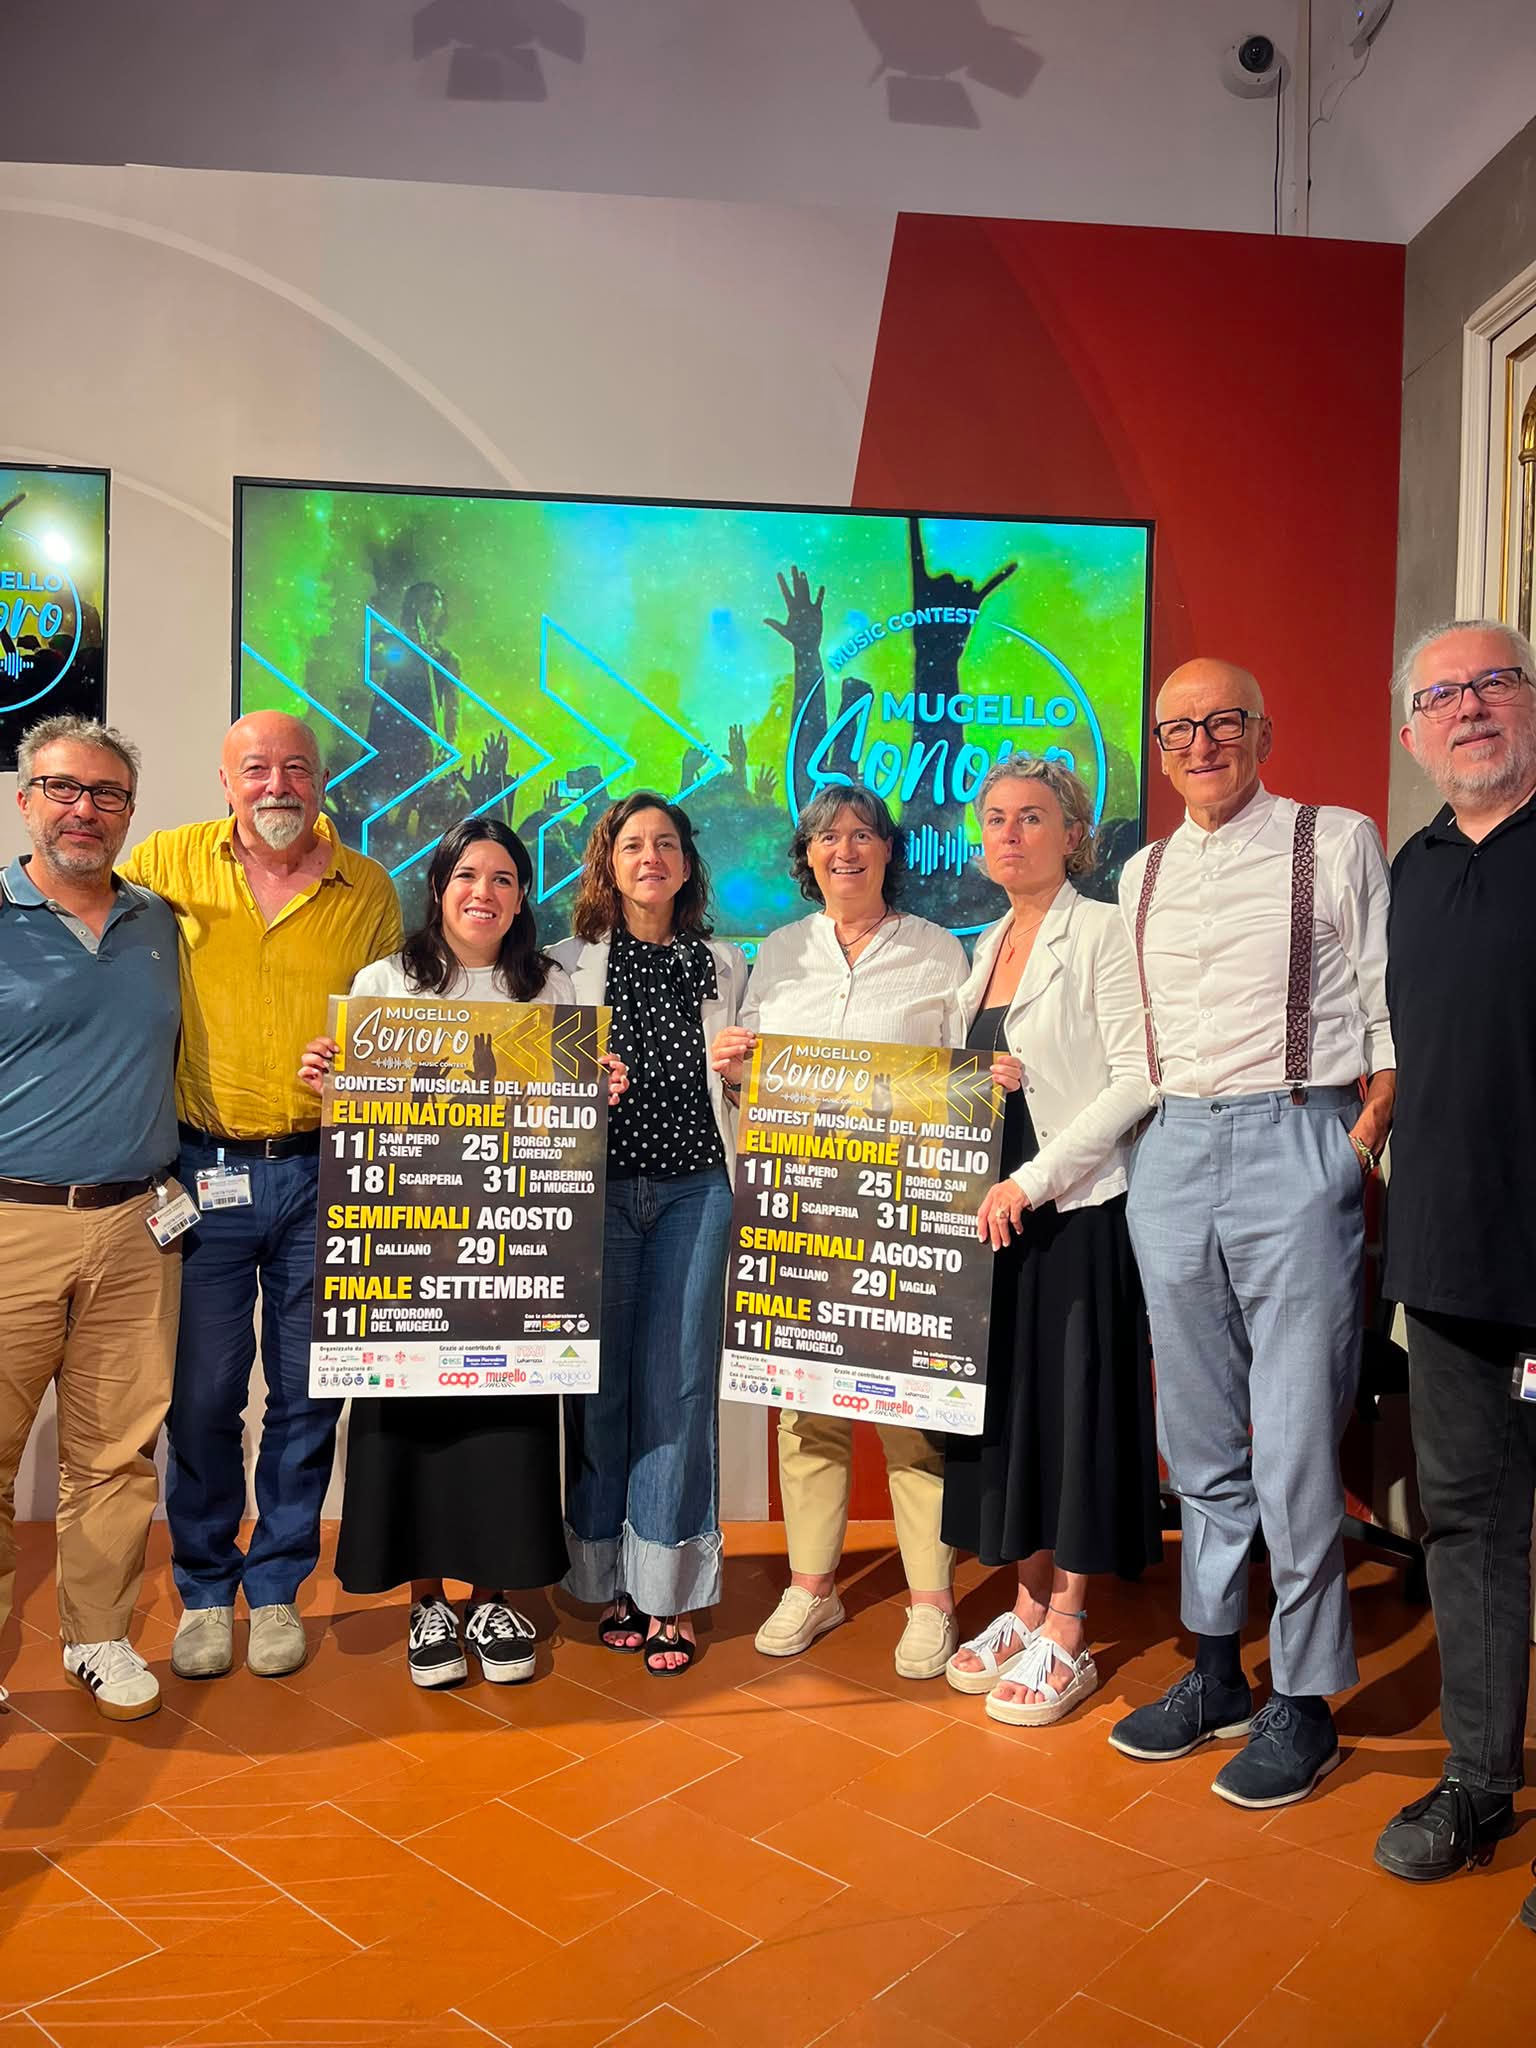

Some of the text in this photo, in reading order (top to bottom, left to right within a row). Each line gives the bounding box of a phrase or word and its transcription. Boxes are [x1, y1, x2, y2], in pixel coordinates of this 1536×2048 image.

[829, 607, 980, 671] MUSIC CONTEST
[882, 692, 1077, 727] MUGELLO
[386, 1007, 470, 1022] MUGELLO
[352, 1006, 470, 1060] Sonoro
[796, 1046, 871, 1062] MUGELLO
[765, 1044, 870, 1093] Sonoro
[334, 1076, 598, 1098] CONTEST MUSICALE DEL MUGELLO
[332, 1100, 597, 1130] ELIMINATORIE LUGLIO
[748, 1107, 992, 1143] CONTEST MUSICALE DEL MUGELLO
[331, 1131, 365, 1159] 11
[379, 1133, 440, 1146] SAN PIERO
[461, 1133, 499, 1161] 25
[513, 1136, 576, 1149] BORGO SAN
[378, 1145, 423, 1158] A SIEVE
[512, 1148, 563, 1160] LORENZO
[745, 1130, 989, 1175] ELIMINATORIE LUGLIO
[346, 1165, 384, 1194] 18
[398, 1172, 463, 1186] SCARPERIA
[483, 1166, 517, 1194] 31
[529, 1170, 593, 1182] BARBERINO
[744, 1159, 773, 1186] 11
[785, 1163, 838, 1179] SAN PIERO
[529, 1182, 595, 1194] DI MUGELLO
[784, 1175, 823, 1189] A SIEVE
[857, 1170, 892, 1199] 25
[905, 1175, 967, 1192] BORGO SAN
[757, 1191, 789, 1219] 18
[904, 1187, 953, 1202] LORENZO
[327, 1205, 573, 1231] SEMIFINALI AGOSTO
[801, 1201, 859, 1219] SCARPERIA
[876, 1202, 908, 1230] 31
[921, 1209, 979, 1226] BARBERIN
[920, 1222, 978, 1238] DI MUGELL
[325, 1236, 361, 1264] 21
[375, 1243, 432, 1256] GALLIANO
[456, 1236, 496, 1264] 29
[509, 1244, 548, 1256] VAGLIA
[739, 1226, 962, 1273] SEMIFINALI AGOSTO
[737, 1255, 767, 1283] 21
[779, 1266, 829, 1282] GALLIANO
[324, 1276, 565, 1300] FINALE SETTEMBRE
[851, 1268, 887, 1298] 29
[899, 1280, 937, 1296] VAGLIA
[322, 1307, 356, 1336] 11
[371, 1308, 443, 1320] AUTODROMO
[735, 1290, 953, 1340] FINALE SETTEMBRE
[371, 1320, 450, 1333] DEL MUGELLO
[734, 1319, 762, 1348] 11
[774, 1326, 838, 1343] AUTODROMO
[774, 1337, 844, 1356] DEL MUGELLO
[438, 1368, 527, 1388] coop mugello
[833, 1394, 914, 1415] coop mugello
